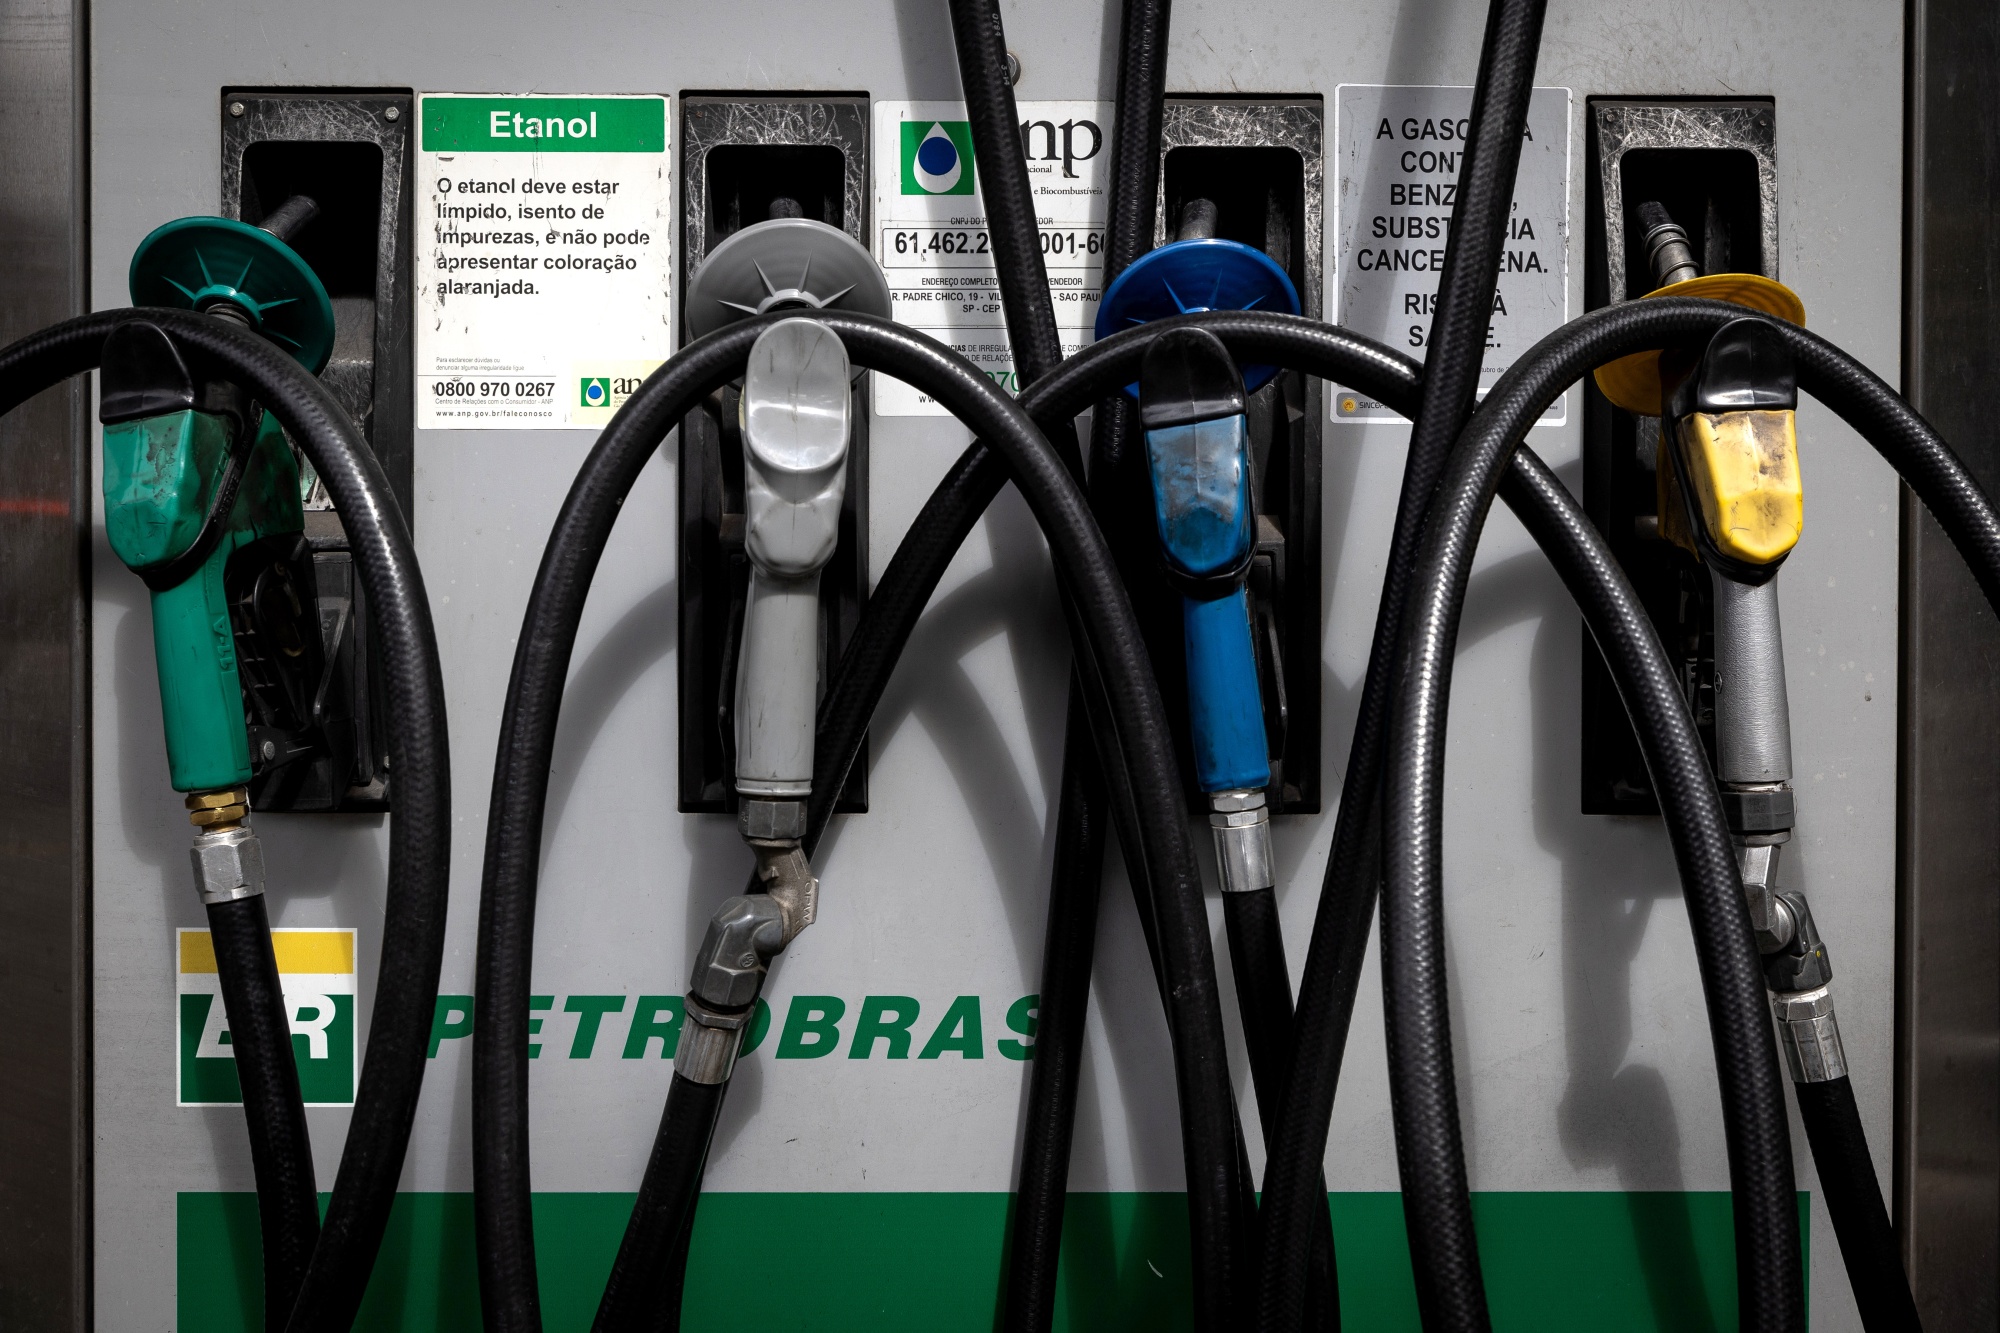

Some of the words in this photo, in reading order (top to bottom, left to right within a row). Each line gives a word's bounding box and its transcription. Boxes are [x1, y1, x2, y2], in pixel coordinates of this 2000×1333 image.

[490, 111, 597, 138] Etanol
[1376, 118, 1394, 140] A
[1401, 118, 1533, 141] GASOA
[1020, 118, 1103, 178] np
[1028, 165, 1052, 173] cional
[1401, 151, 1464, 173] CON
[437, 178, 452, 193] O
[458, 178, 515, 193] etanol
[521, 178, 566, 193] deve
[572, 179, 620, 194] estar
[1040, 186, 1103, 195] Biocombustíveis
[1391, 184, 1517, 210] BENZ,
[437, 203, 512, 222] límpido,
[519, 203, 576, 219] isento
[582, 203, 605, 219] de
[970, 217, 980, 225] DO
[437, 231, 540, 248] impurezas,
[546, 232, 558, 244] e
[563, 229, 597, 244] não
[604, 229, 650, 248] pode
[437, 255, 538, 273] apresentar
[544, 254, 637, 273] coloração
[437, 278, 540, 299] alaranjada.
[921, 277, 958, 287] ENDEREÇO
[960, 277, 998, 286] COMPLETO
[892, 292, 900, 301] R.
[903, 292, 932, 301] PADRE
[935, 292, 966, 302] CHICO,
[969, 292, 978, 301] 19
[989, 292, 1002, 301] VIL
[963, 304, 974, 313] SP
[982, 304, 1000, 313] CEP
[968, 344, 977, 352] DE
[982, 352, 1013, 363] RELAÇÕE
[436, 382, 475, 397] 0800
[480, 382, 510, 397] 970
[515, 382, 556, 397] 0267
[613, 377, 643, 395] an
[462, 398, 487, 406] Relações
[436, 410, 553, 418] www.anp.gov.br/faleconosco
